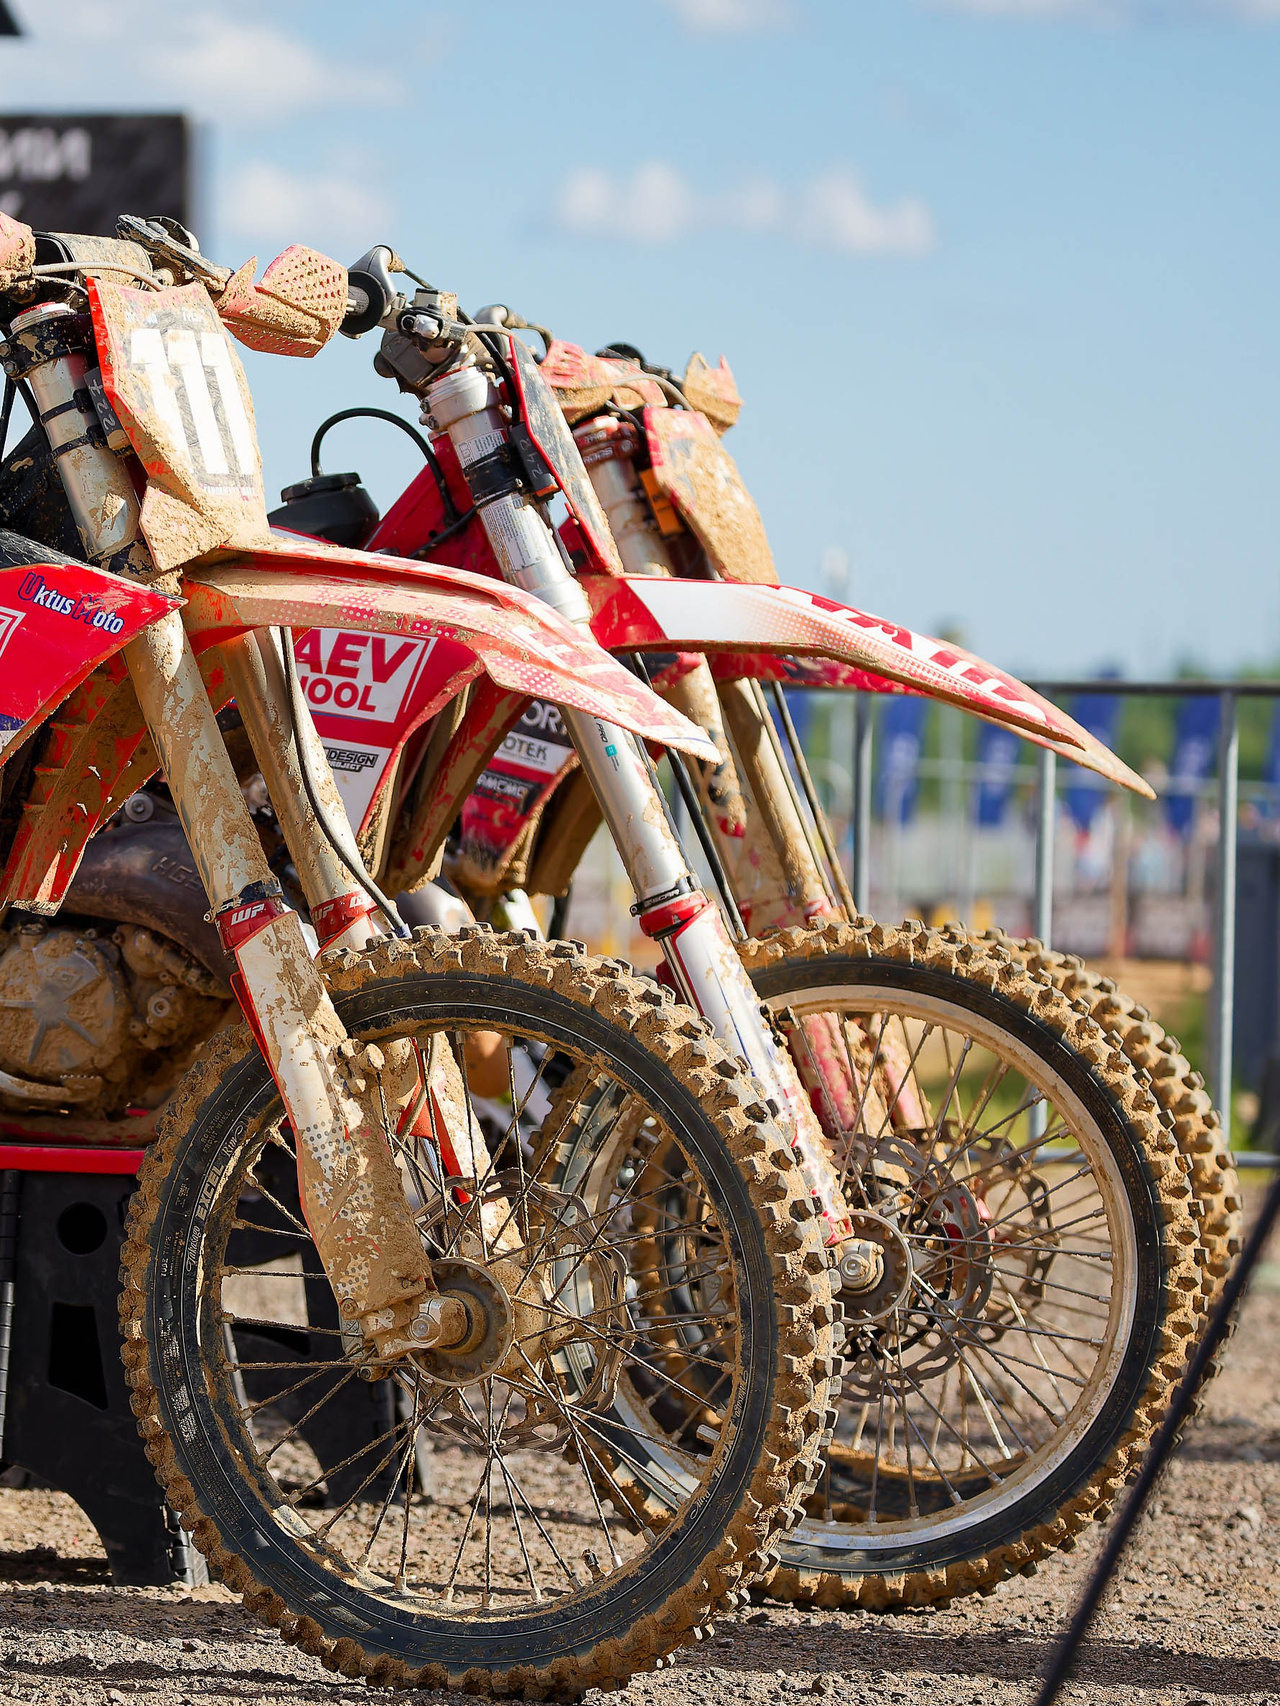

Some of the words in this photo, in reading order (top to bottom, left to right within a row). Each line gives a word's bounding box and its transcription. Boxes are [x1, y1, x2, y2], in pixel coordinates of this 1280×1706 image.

[130, 326, 255, 475] 111
[327, 751, 377, 766] DESIGN
[230, 903, 265, 926] WP
[195, 1163, 226, 1222] EXCEL
